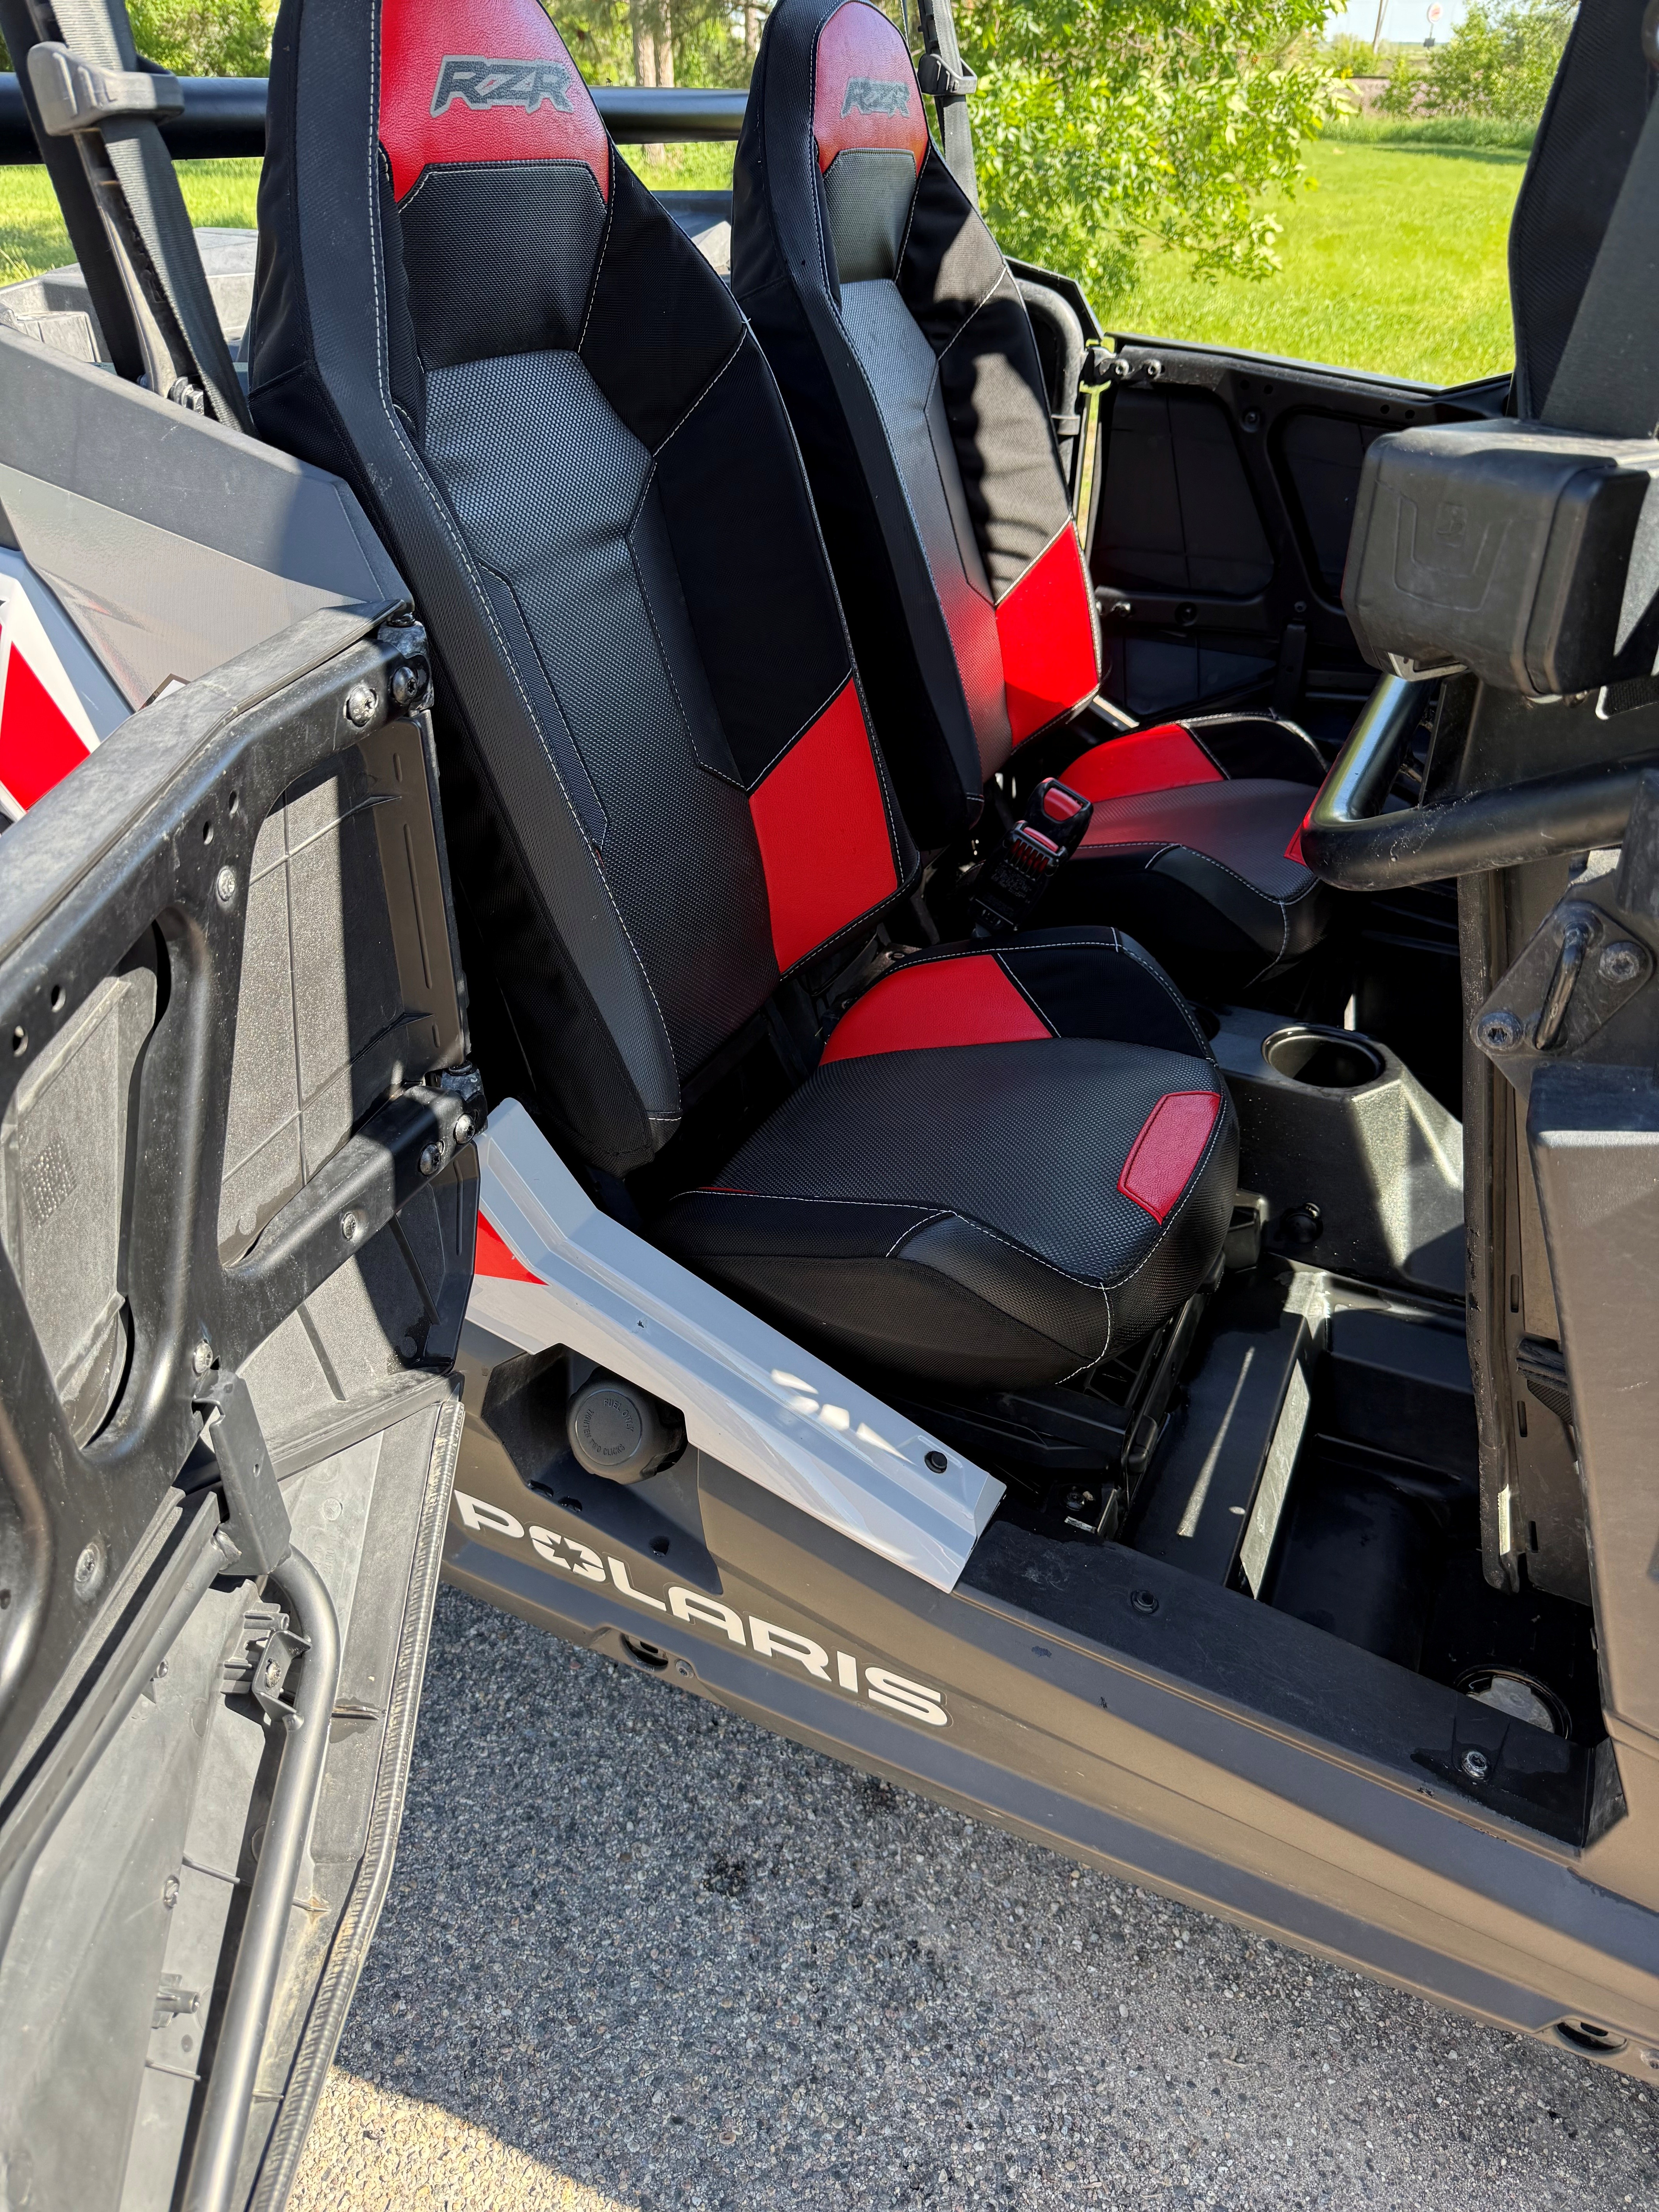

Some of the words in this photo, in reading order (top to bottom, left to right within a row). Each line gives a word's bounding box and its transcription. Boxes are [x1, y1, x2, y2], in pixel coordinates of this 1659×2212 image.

[430, 55, 574, 118] RZR
[840, 77, 910, 118] RZR
[604, 1398, 621, 1411] FUEL
[622, 1410, 634, 1432] ONLY
[603, 1444, 625, 1456] CLICKS
[454, 1489, 948, 1726] POLARIS
